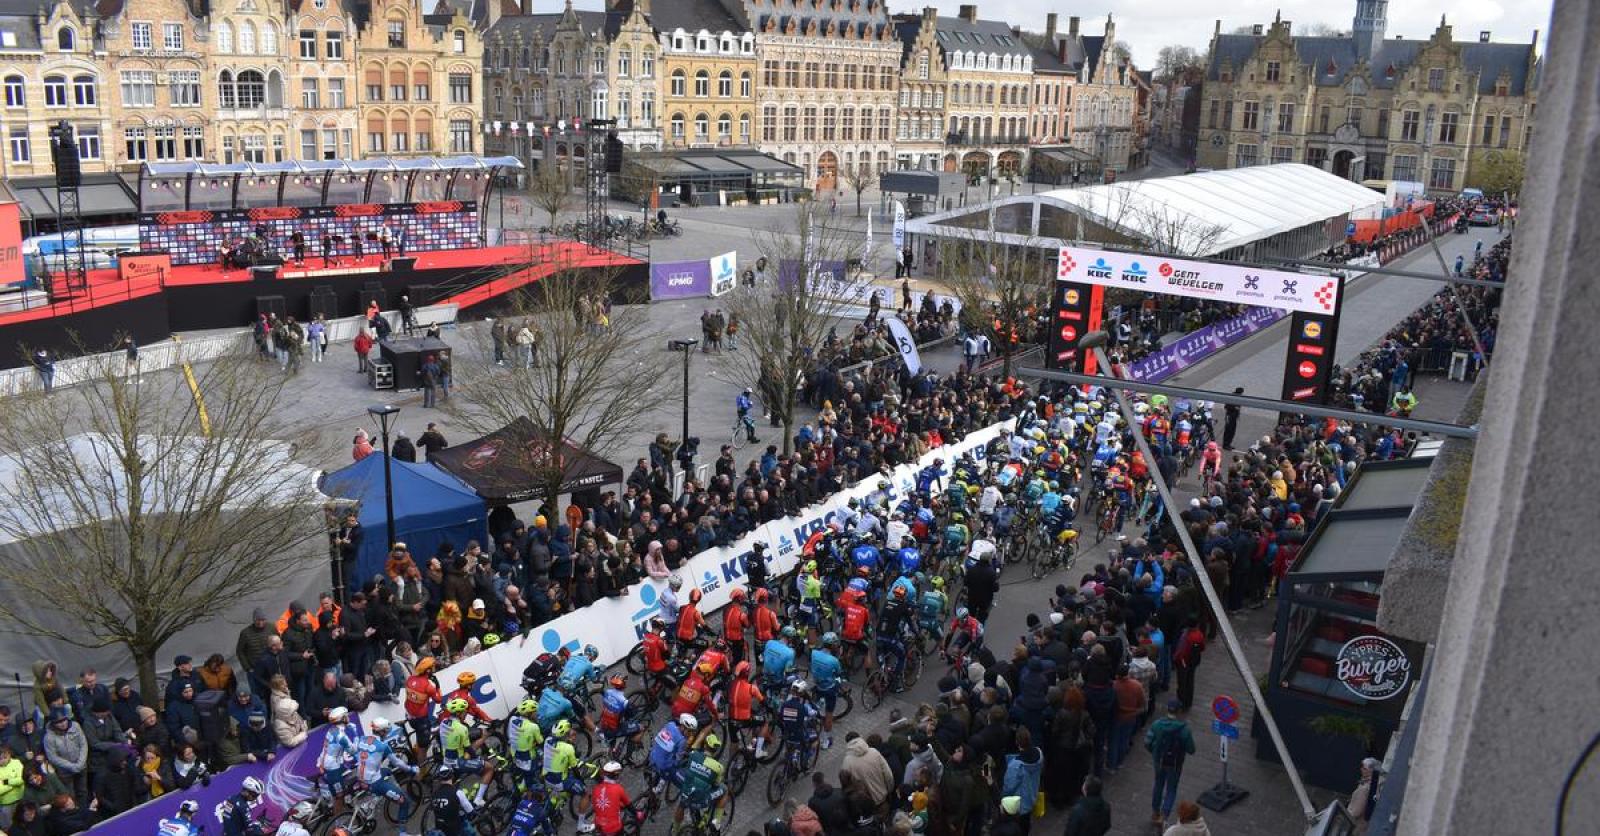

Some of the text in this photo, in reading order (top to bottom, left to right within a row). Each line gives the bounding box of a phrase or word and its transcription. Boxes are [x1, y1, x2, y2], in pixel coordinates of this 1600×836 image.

[1087, 269, 1112, 280] KBC
[1121, 273, 1147, 284] KBC
[1174, 270, 1200, 280] GENT
[668, 277, 693, 287] KPMG
[1167, 277, 1224, 292] WEVELGEM
[778, 544, 794, 556] KBC
[702, 580, 721, 595] KBC
[1352, 644, 1389, 657] YPRES
[1335, 656, 1411, 684] Burger
